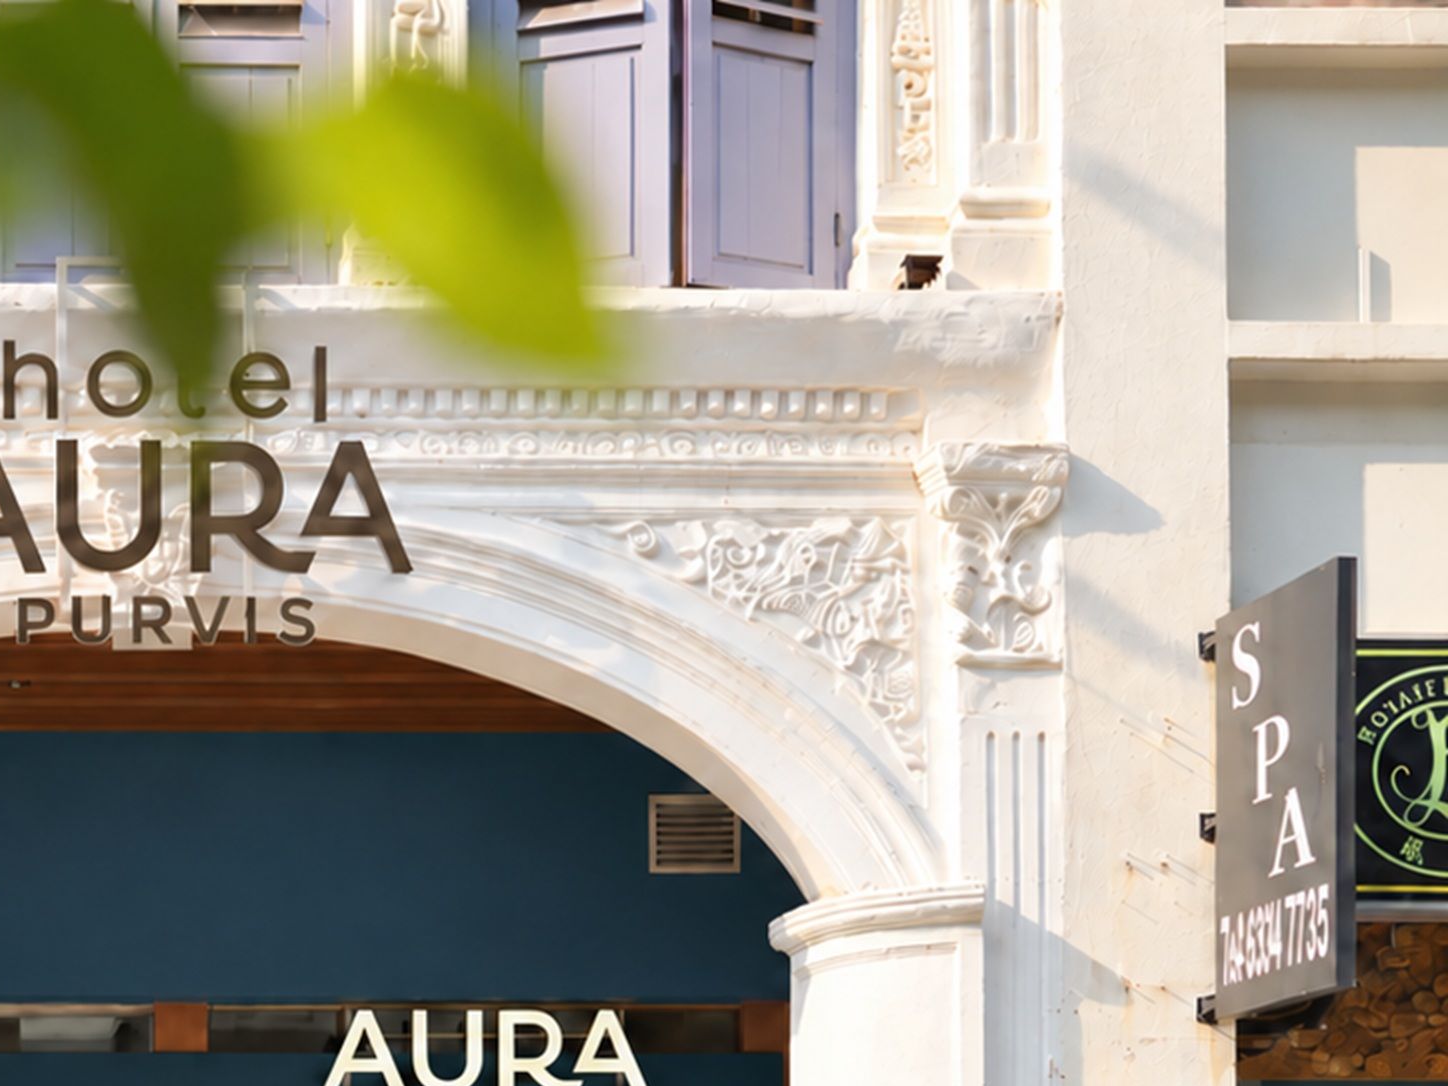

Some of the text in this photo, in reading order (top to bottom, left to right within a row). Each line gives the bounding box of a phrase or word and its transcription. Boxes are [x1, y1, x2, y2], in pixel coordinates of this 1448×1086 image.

[15, 595, 317, 645] PURVIS
[1231, 621, 1316, 878] SPA
[1284, 883, 1329, 967] 7735
